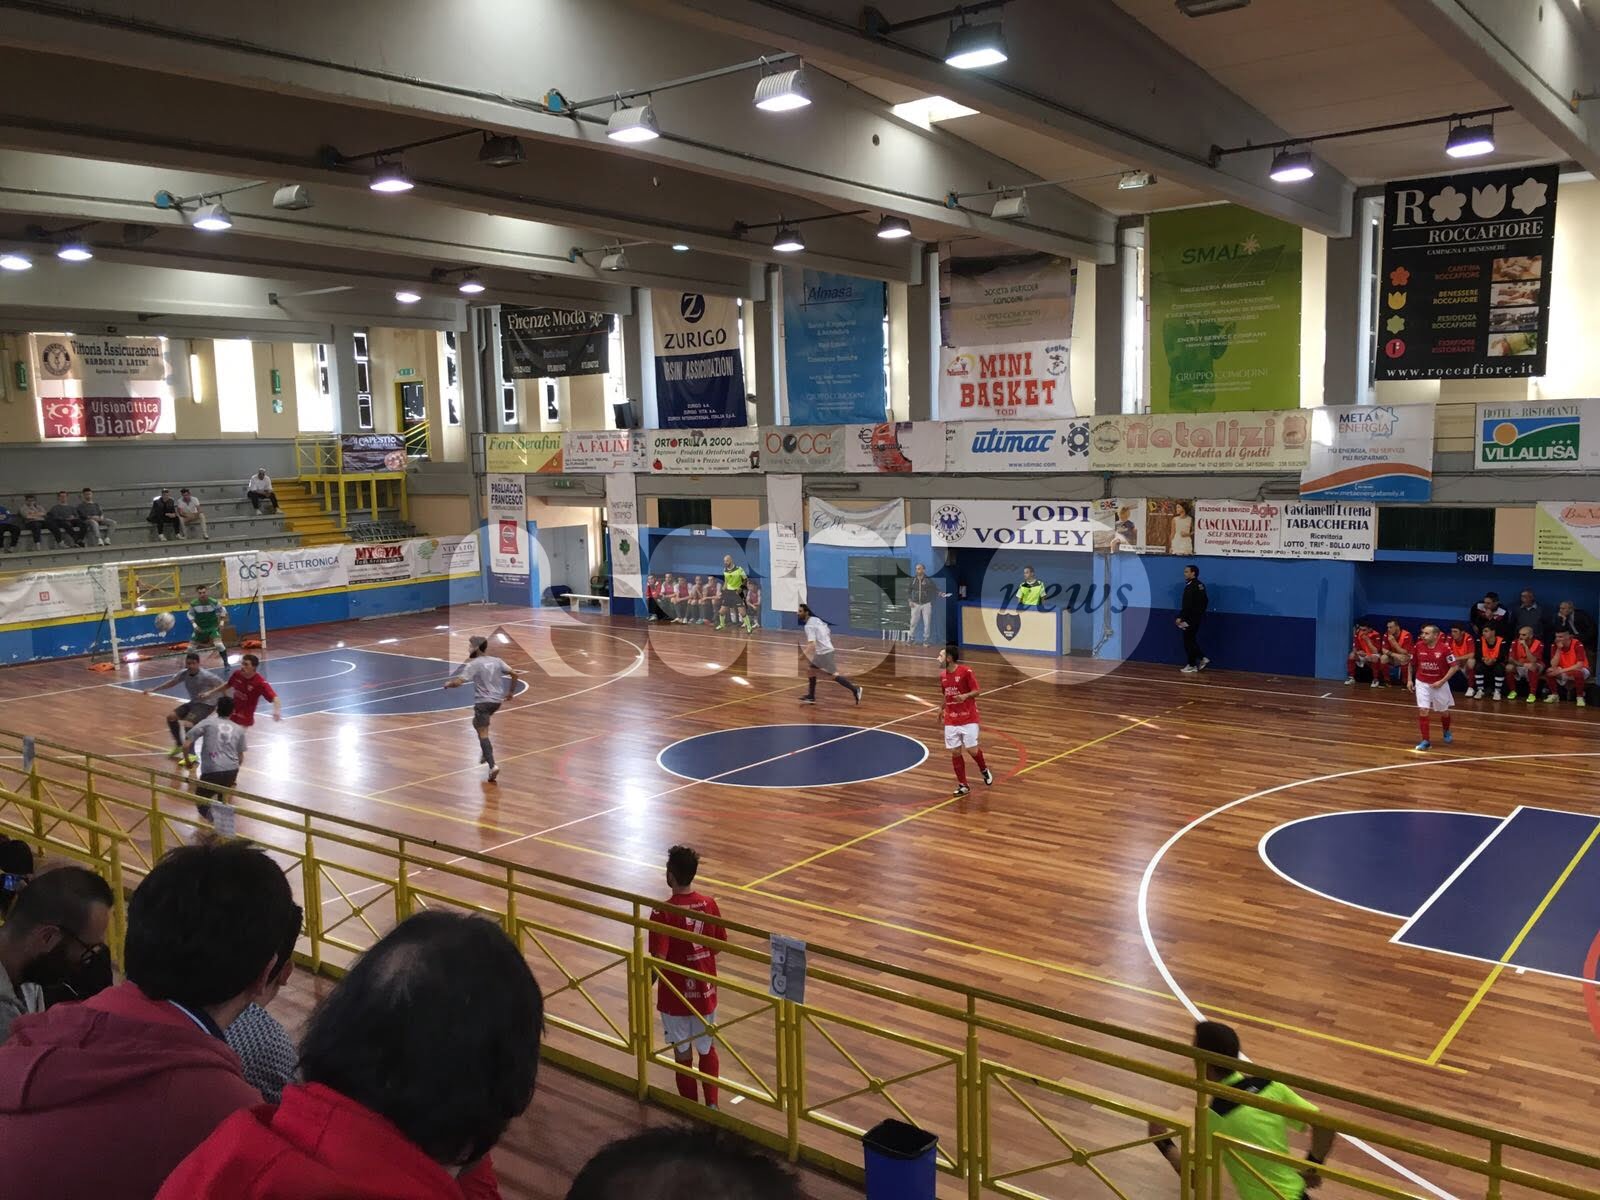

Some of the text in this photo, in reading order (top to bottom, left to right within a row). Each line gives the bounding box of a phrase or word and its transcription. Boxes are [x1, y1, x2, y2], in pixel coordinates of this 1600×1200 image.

[1393, 189, 1427, 226] R
[1428, 220, 1544, 243] ROCCAFIORE
[1434, 272, 1480, 280] ROCCAFIORE
[808, 286, 853, 300] Almasa
[1438, 289, 1479, 298] BENESSERE
[683, 294, 701, 318] Z
[1432, 297, 1478, 305] ROCCAFIORE
[507, 309, 586, 329] Firenze Moda
[1437, 314, 1477, 322] RESIDENZA
[664, 328, 727, 349] ZURIGO
[103, 341, 160, 357] Assicurazioni
[979, 352, 1032, 379] MINI
[1386, 363, 1533, 377] www.roccafiore.it
[1176, 370, 1214, 382] GRUPPO
[960, 379, 1056, 408] BASKET
[994, 408, 1018, 416] TODI
[1339, 413, 1374, 423] META
[1484, 408, 1511, 418] HOTEL
[1522, 406, 1581, 417] RISTORANTE
[1338, 423, 1390, 433] ENERGIA
[516, 435, 561, 450] Serafini
[576, 439, 630, 453] A. FALINI
[709, 437, 733, 446] 2000
[1225, 447, 1237, 458] di
[1239, 447, 1271, 460] Grutti
[1485, 445, 1577, 460] VILLALUISA
[491, 494, 523, 505] FRANCESCO
[938, 506, 961, 516] TODI
[1012, 505, 1091, 523] TODI
[1251, 504, 1278, 518] Agip
[1285, 503, 1335, 516] Cascianelli
[1197, 518, 1262, 531] CASCIANELLI
[1286, 518, 1369, 530] TABACCHERIA
[973, 528, 1091, 546] VOLLEY
[1352, 542, 1371, 550] AUTO
[277, 556, 339, 571] ELETTRONICA
[1464, 554, 1489, 562] OSPITI
